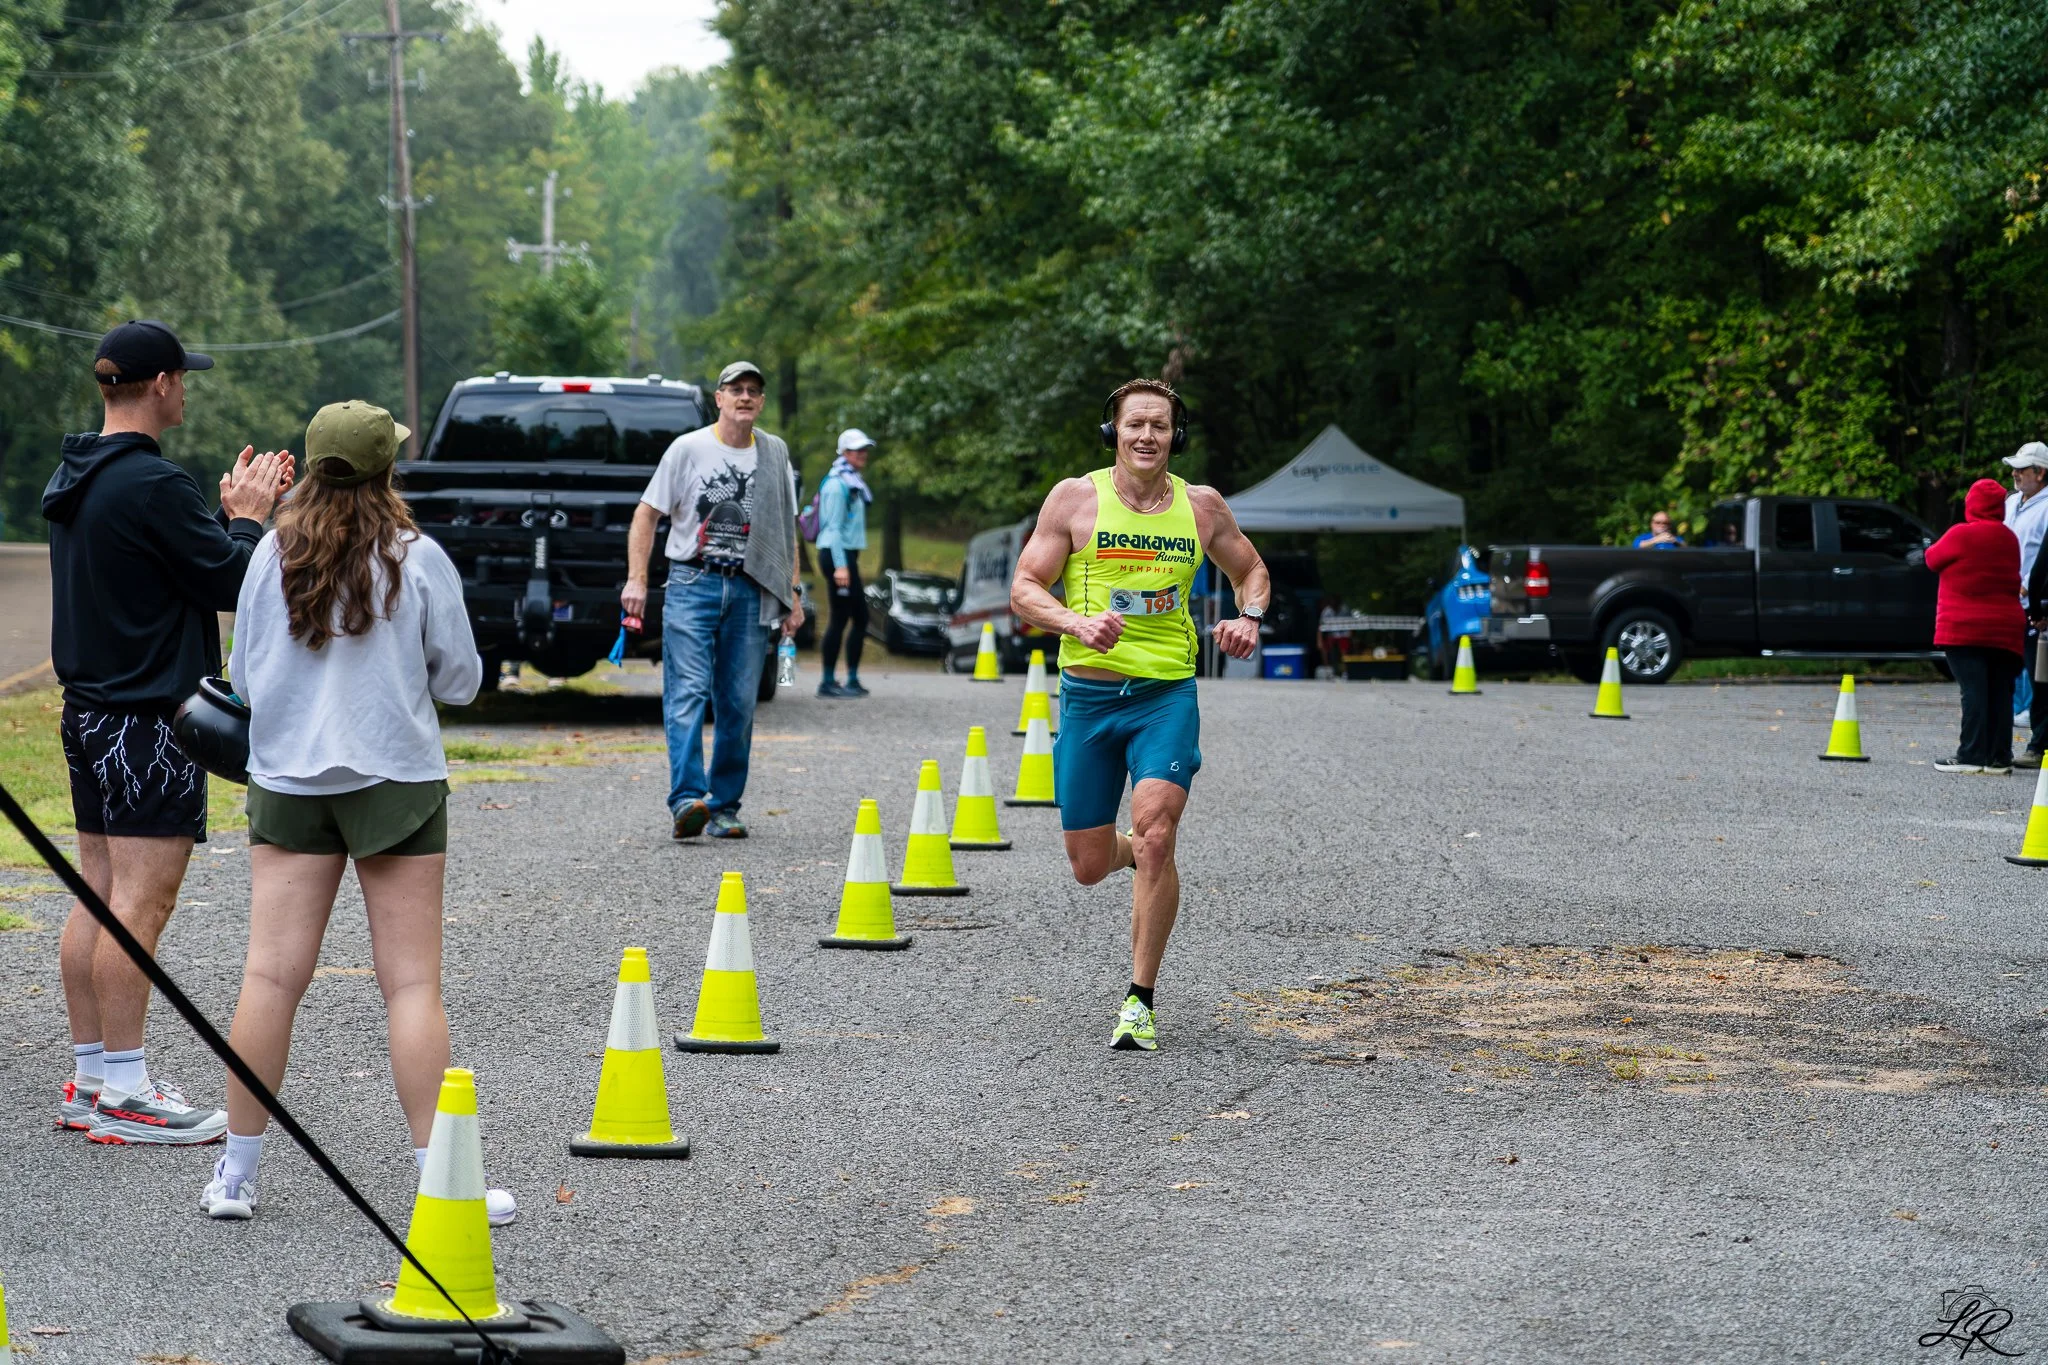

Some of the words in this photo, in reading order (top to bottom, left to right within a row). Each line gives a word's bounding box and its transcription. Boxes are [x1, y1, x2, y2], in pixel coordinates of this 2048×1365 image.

[1097, 531, 1195, 557] Breakaway
[1155, 551, 1195, 567] Running
[1120, 565, 1174, 574] MEMPHIS
[1145, 594, 1174, 614] 195
[102, 1109, 168, 1127] ALTRA
